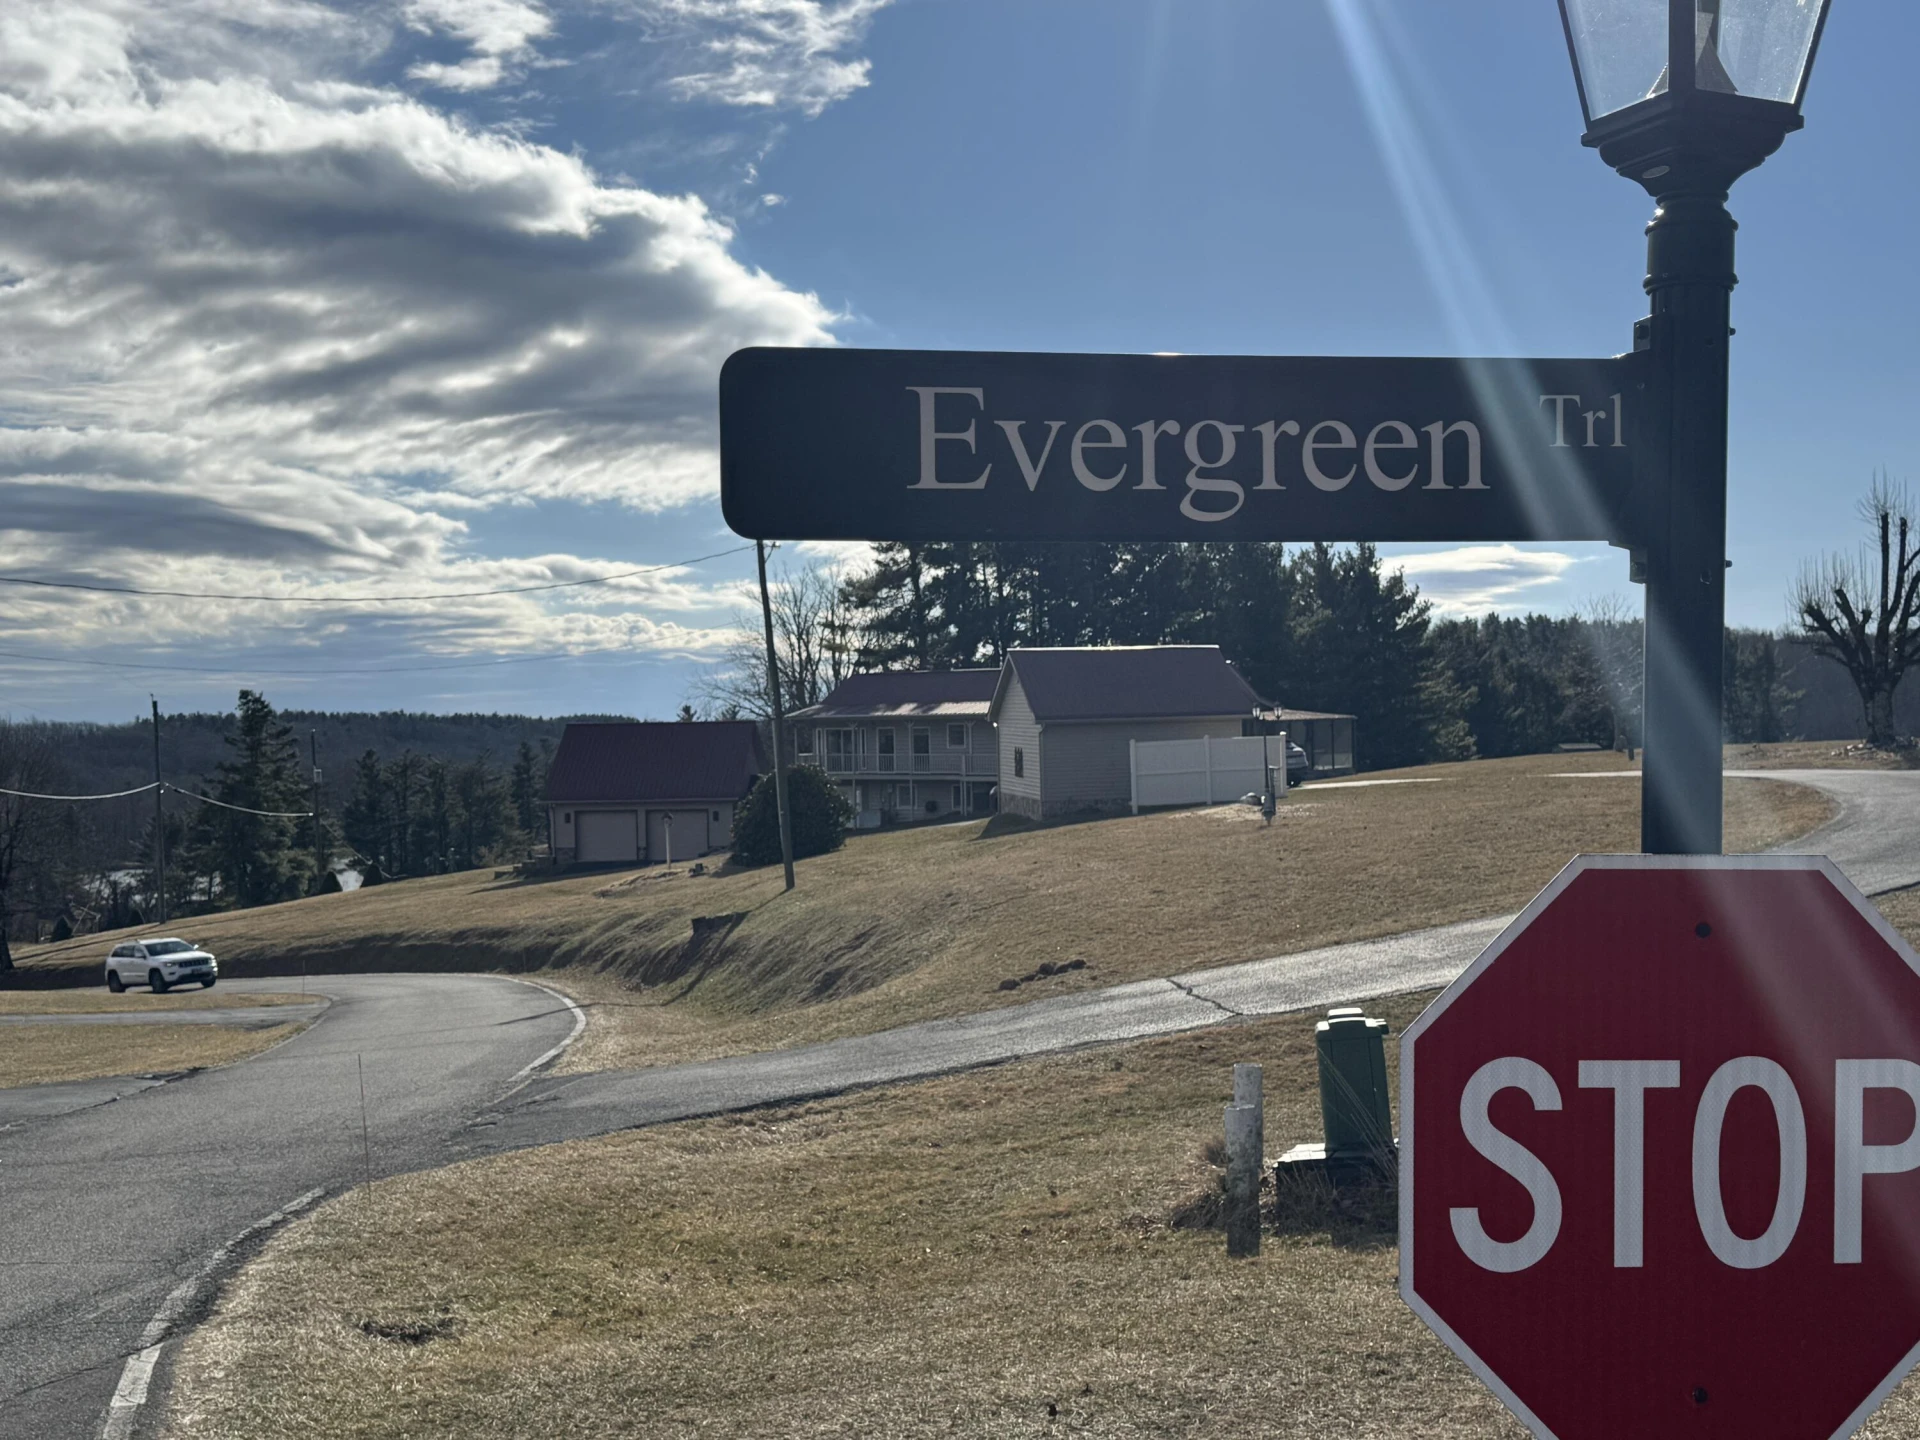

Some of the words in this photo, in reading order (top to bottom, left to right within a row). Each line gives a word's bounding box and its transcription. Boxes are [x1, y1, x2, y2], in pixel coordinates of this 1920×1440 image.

[905, 386, 1491, 523] Evergreen
[1539, 392, 1626, 448] Trl
[1449, 1056, 1920, 1273] STOP
